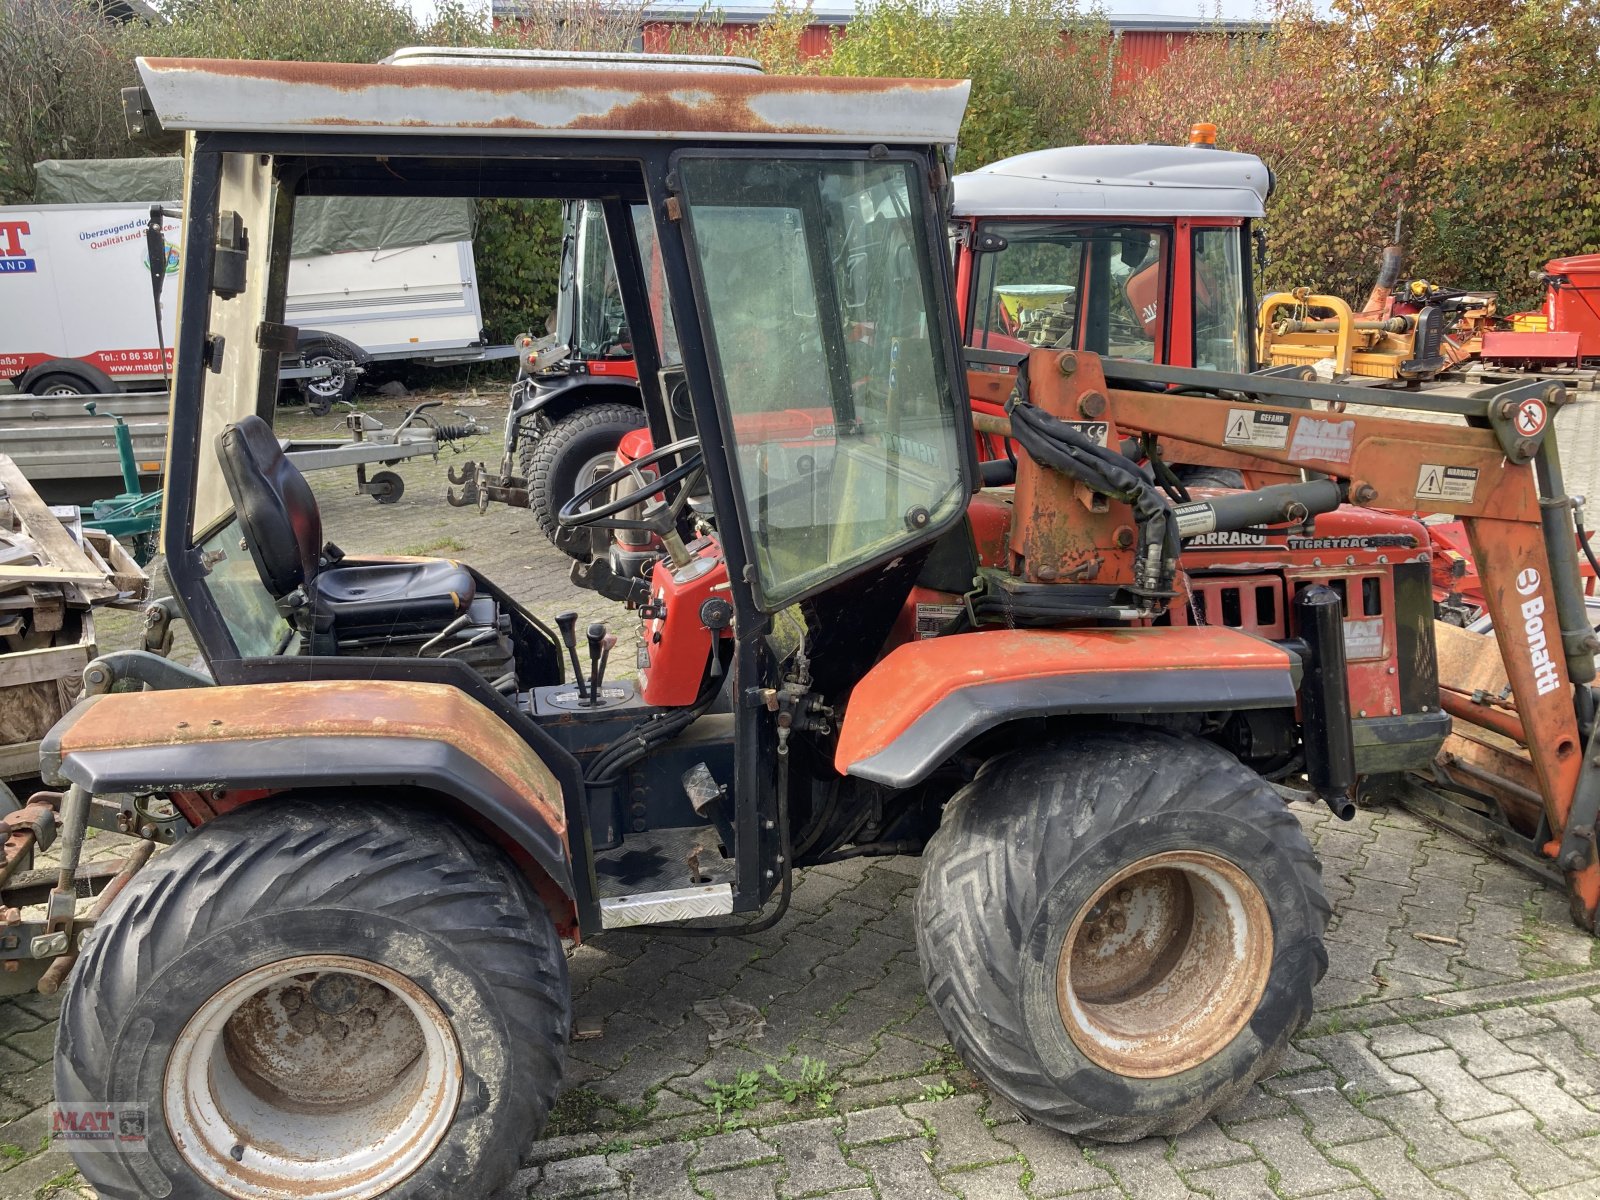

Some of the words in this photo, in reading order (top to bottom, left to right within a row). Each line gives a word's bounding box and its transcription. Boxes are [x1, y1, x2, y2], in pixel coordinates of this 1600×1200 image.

[79, 221, 134, 241] Überzeugend
[90, 235, 124, 250] Qualität
[125, 230, 141, 241] und
[19, 356, 25, 365] 7
[99, 353, 119, 362] Tel.:
[121, 353, 127, 361] 0
[129, 352, 140, 361] 86
[143, 351, 154, 360] 38
[1260, 413, 1284, 423] GEFAHR
[1447, 468, 1477, 478] WARNUNG
[1174, 503, 1208, 515] WARNUNG
[1290, 538, 1369, 549] TIGRETRAC
[1521, 596, 1560, 696] Bonatti
